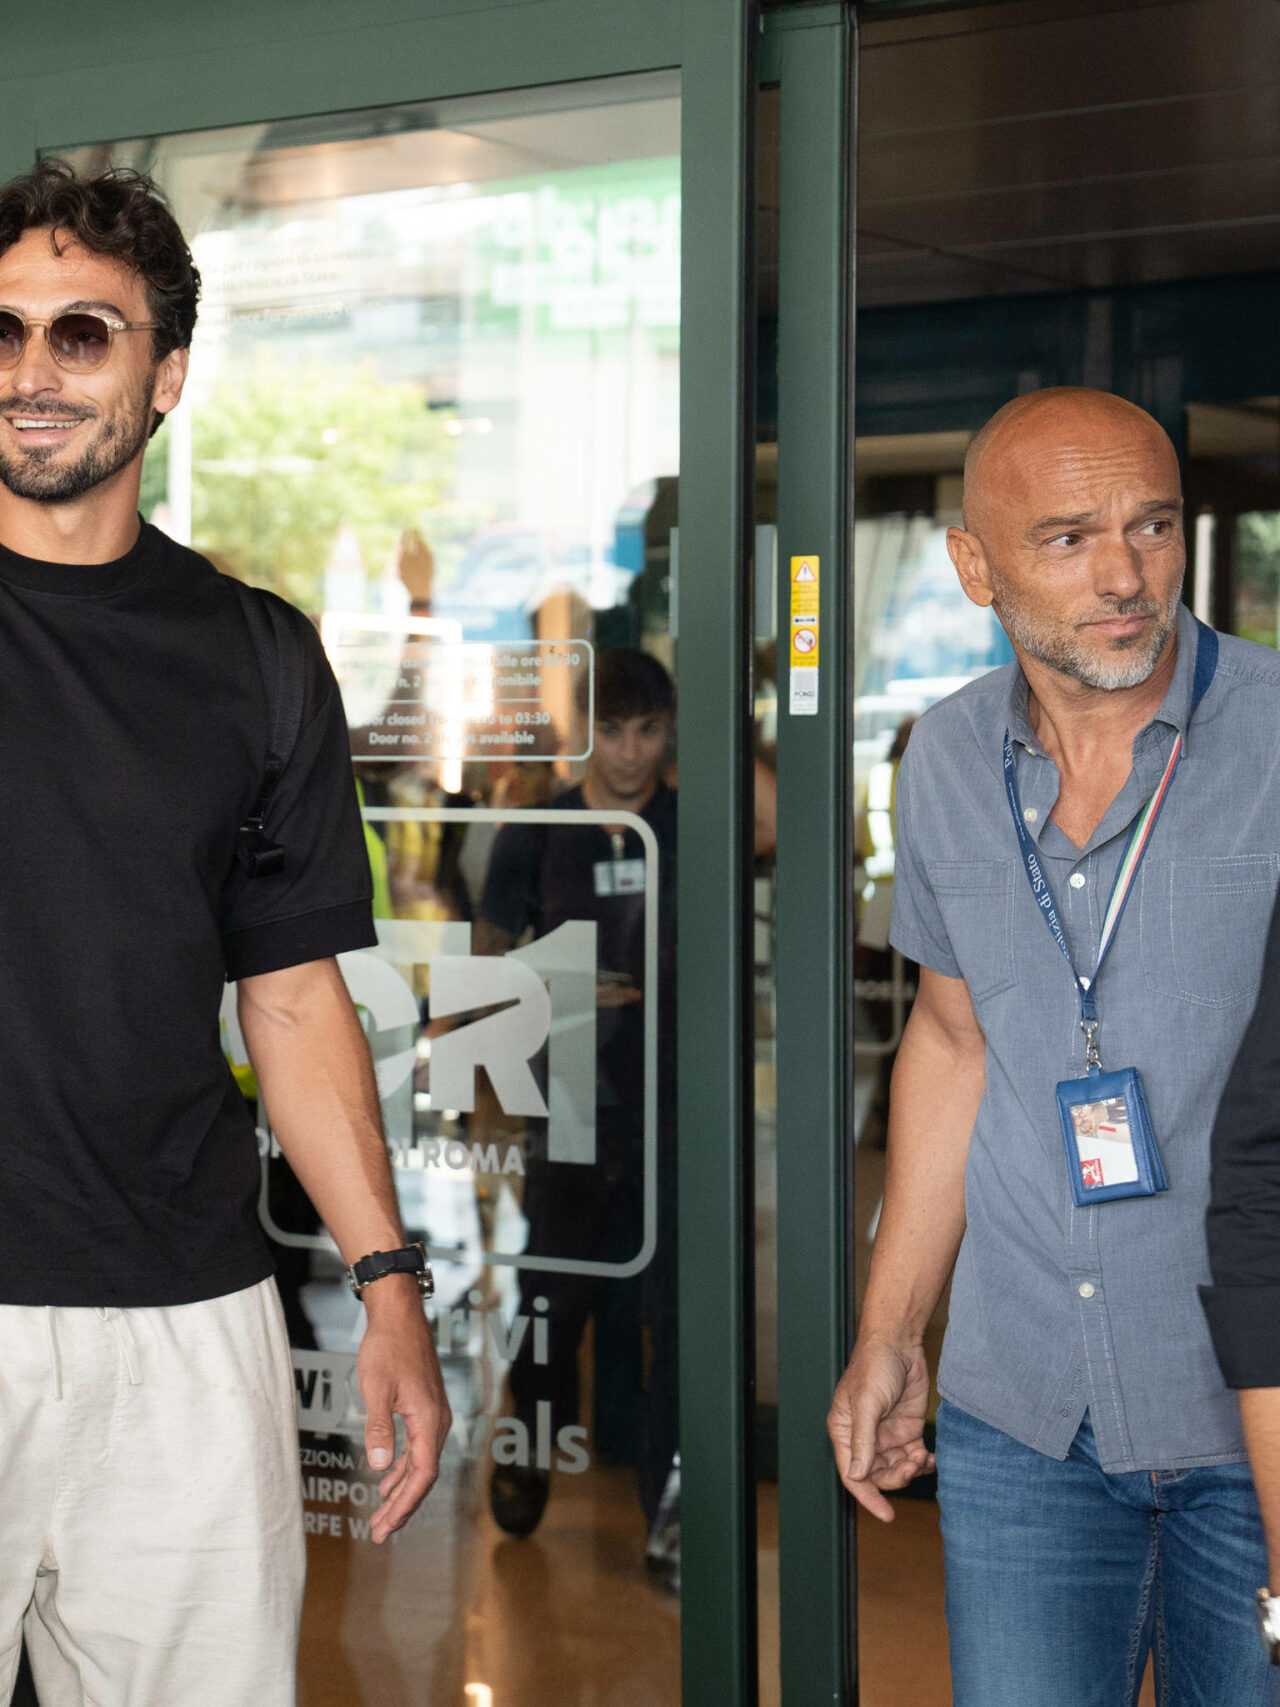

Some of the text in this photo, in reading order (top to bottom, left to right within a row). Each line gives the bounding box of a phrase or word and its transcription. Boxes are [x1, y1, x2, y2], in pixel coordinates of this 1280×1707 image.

[520, 656, 542, 667] ore
[387, 713, 426, 726] closed
[499, 713, 512, 725] to
[515, 711, 550, 725] 03:30
[368, 731, 401, 745] Door
[402, 733, 421, 745] no.
[424, 731, 432, 745] 2
[479, 730, 535, 745] available
[1027, 852, 1047, 895] Stato
[1037, 894, 1052, 910] di
[422, 1138, 526, 1176] ROMA
